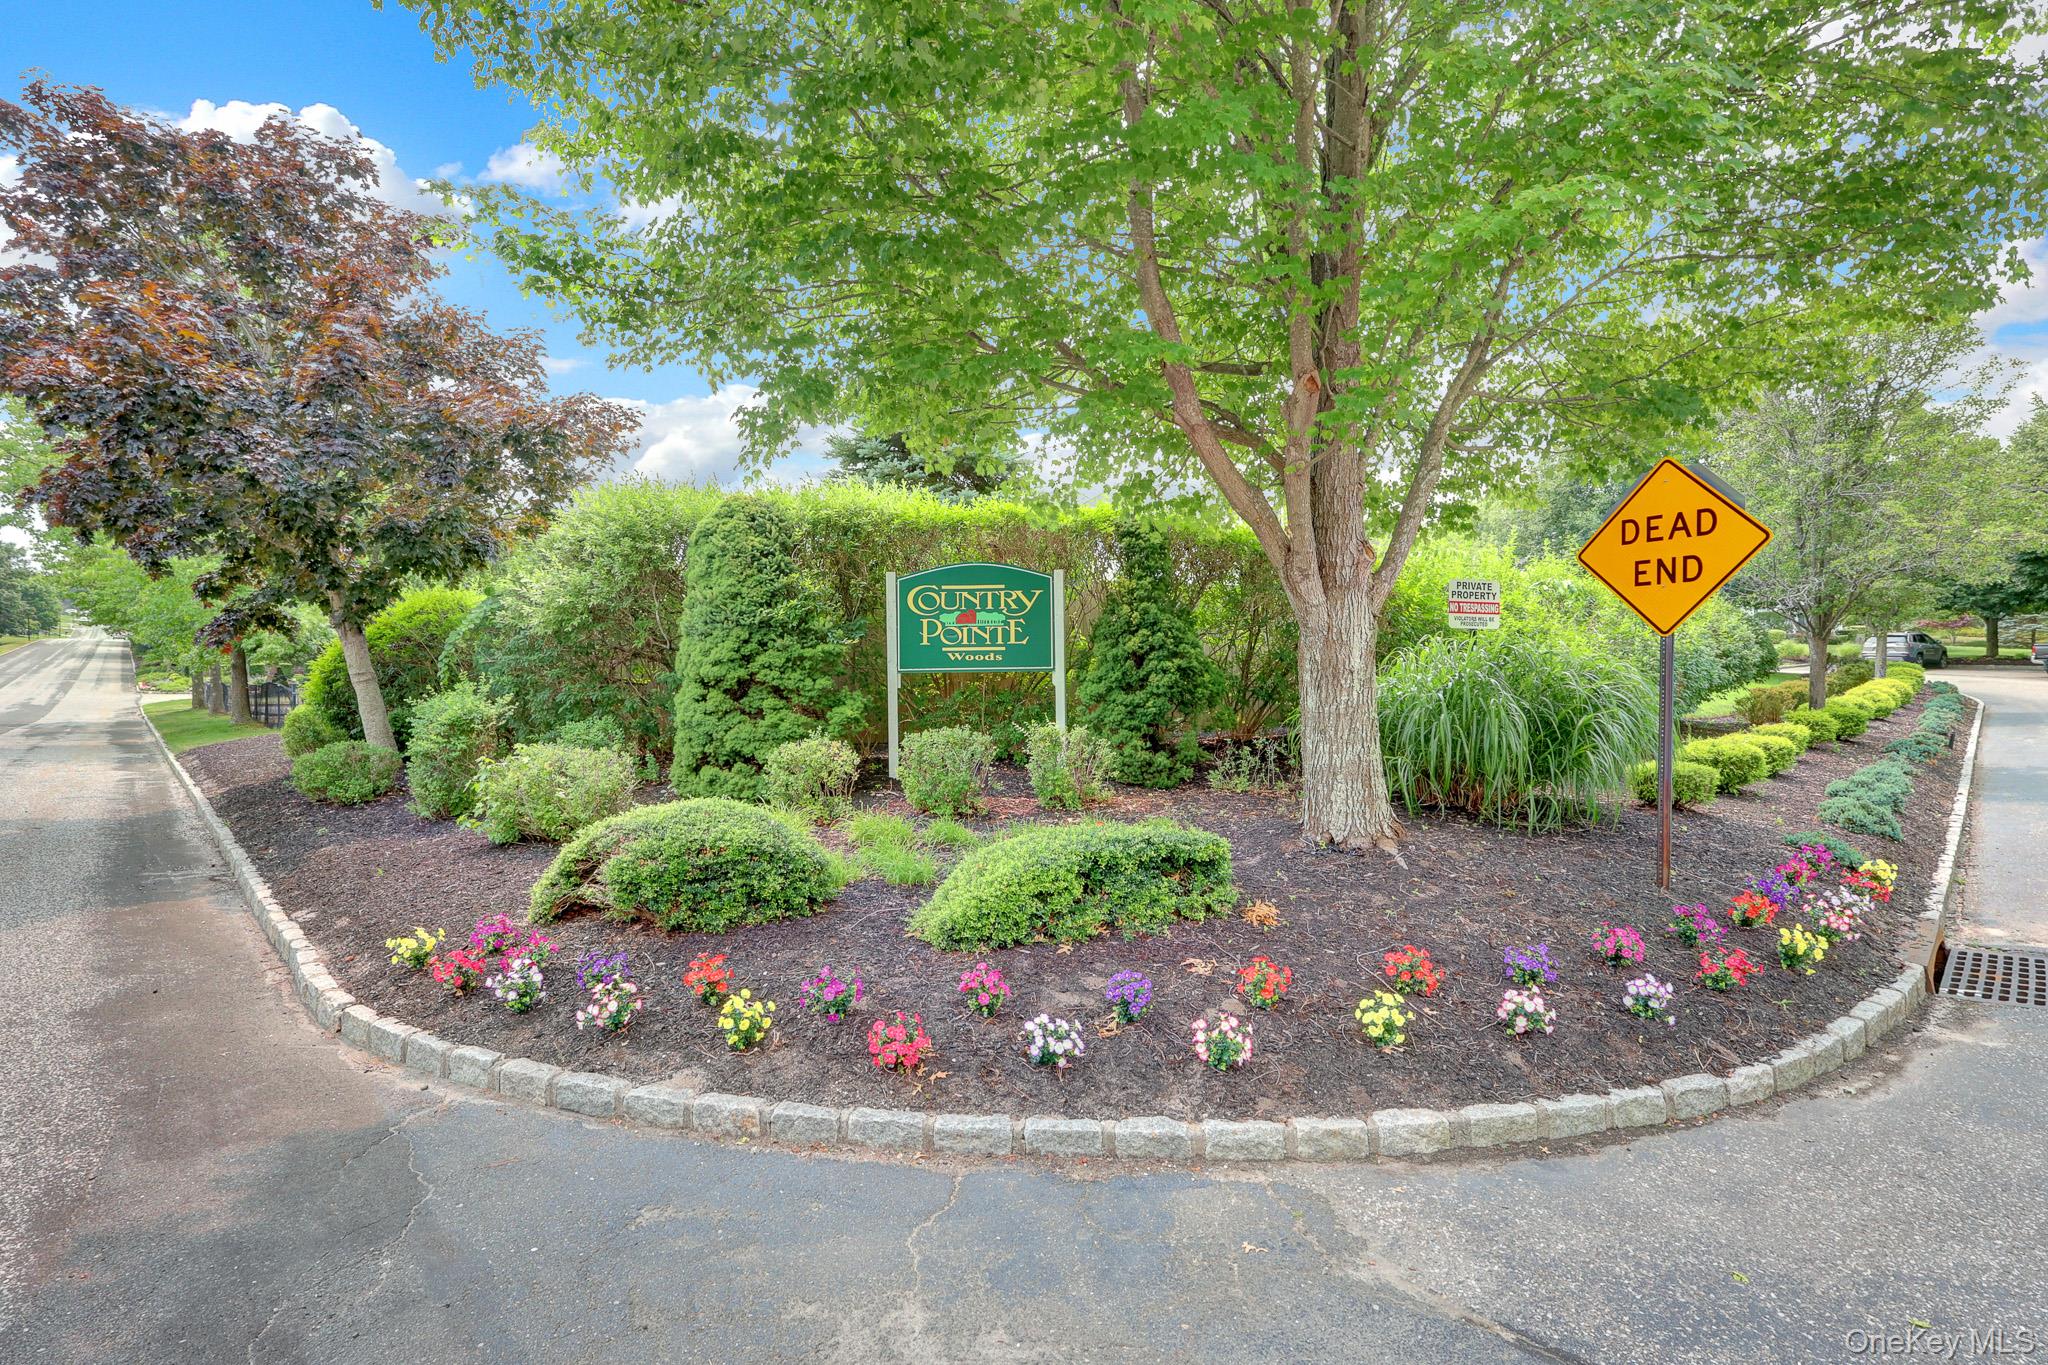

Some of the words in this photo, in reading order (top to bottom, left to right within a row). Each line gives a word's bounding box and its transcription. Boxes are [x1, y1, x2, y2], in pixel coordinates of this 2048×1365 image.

[1621, 508, 1718, 546] DEAD
[1634, 555, 1703, 587] END
[1451, 590, 1497, 600] PROPERTY
[1456, 581, 1493, 591] PRIVATE
[907, 585, 1043, 616] COUNTRY
[1449, 602, 1459, 613] NO
[1460, 603, 1499, 614] TRESPASSING
[920, 618, 1029, 646] POINTE
[947, 652, 1003, 661] Woods
